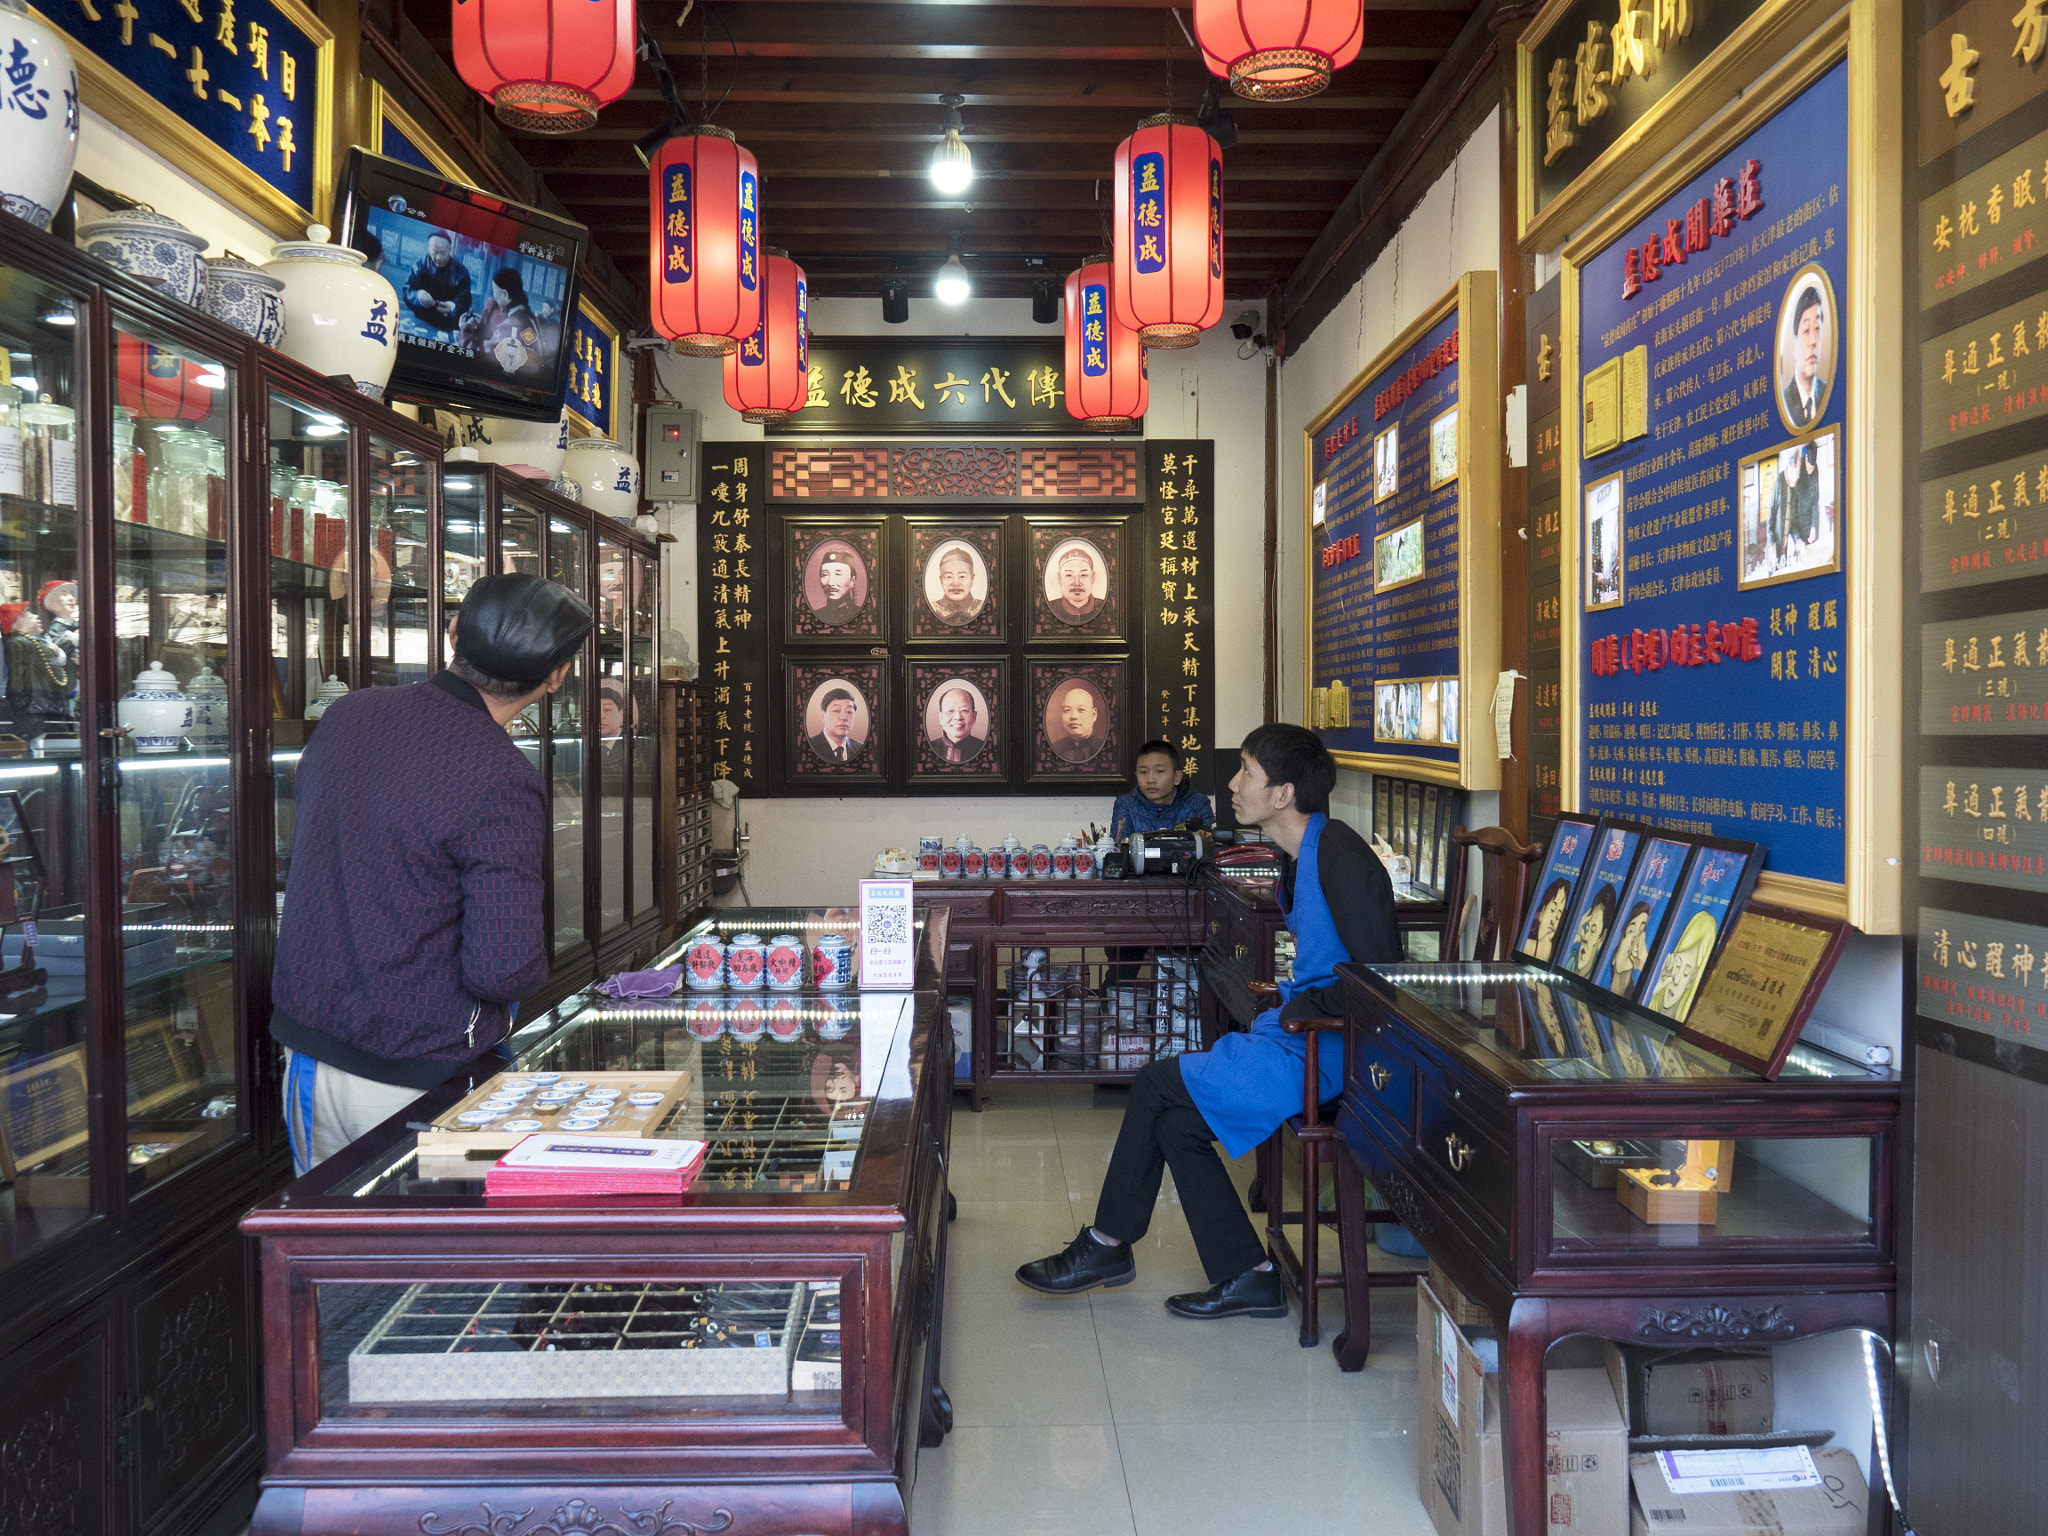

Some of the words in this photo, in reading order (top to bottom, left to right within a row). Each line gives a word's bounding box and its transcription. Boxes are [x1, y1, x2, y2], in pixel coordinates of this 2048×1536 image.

[667, 173, 690, 275] 益德成
[741, 182, 756, 284] 益德成
[1138, 162, 1162, 264] 益德成
[360, 298, 388, 347] 益
[1085, 292, 1105, 370] 益德成
[613, 466, 632, 494] 益
[732, 456, 752, 630] 周身舒泰長精神
[1770, 603, 1797, 636] 提神
[1808, 646, 1837, 679] 清心
